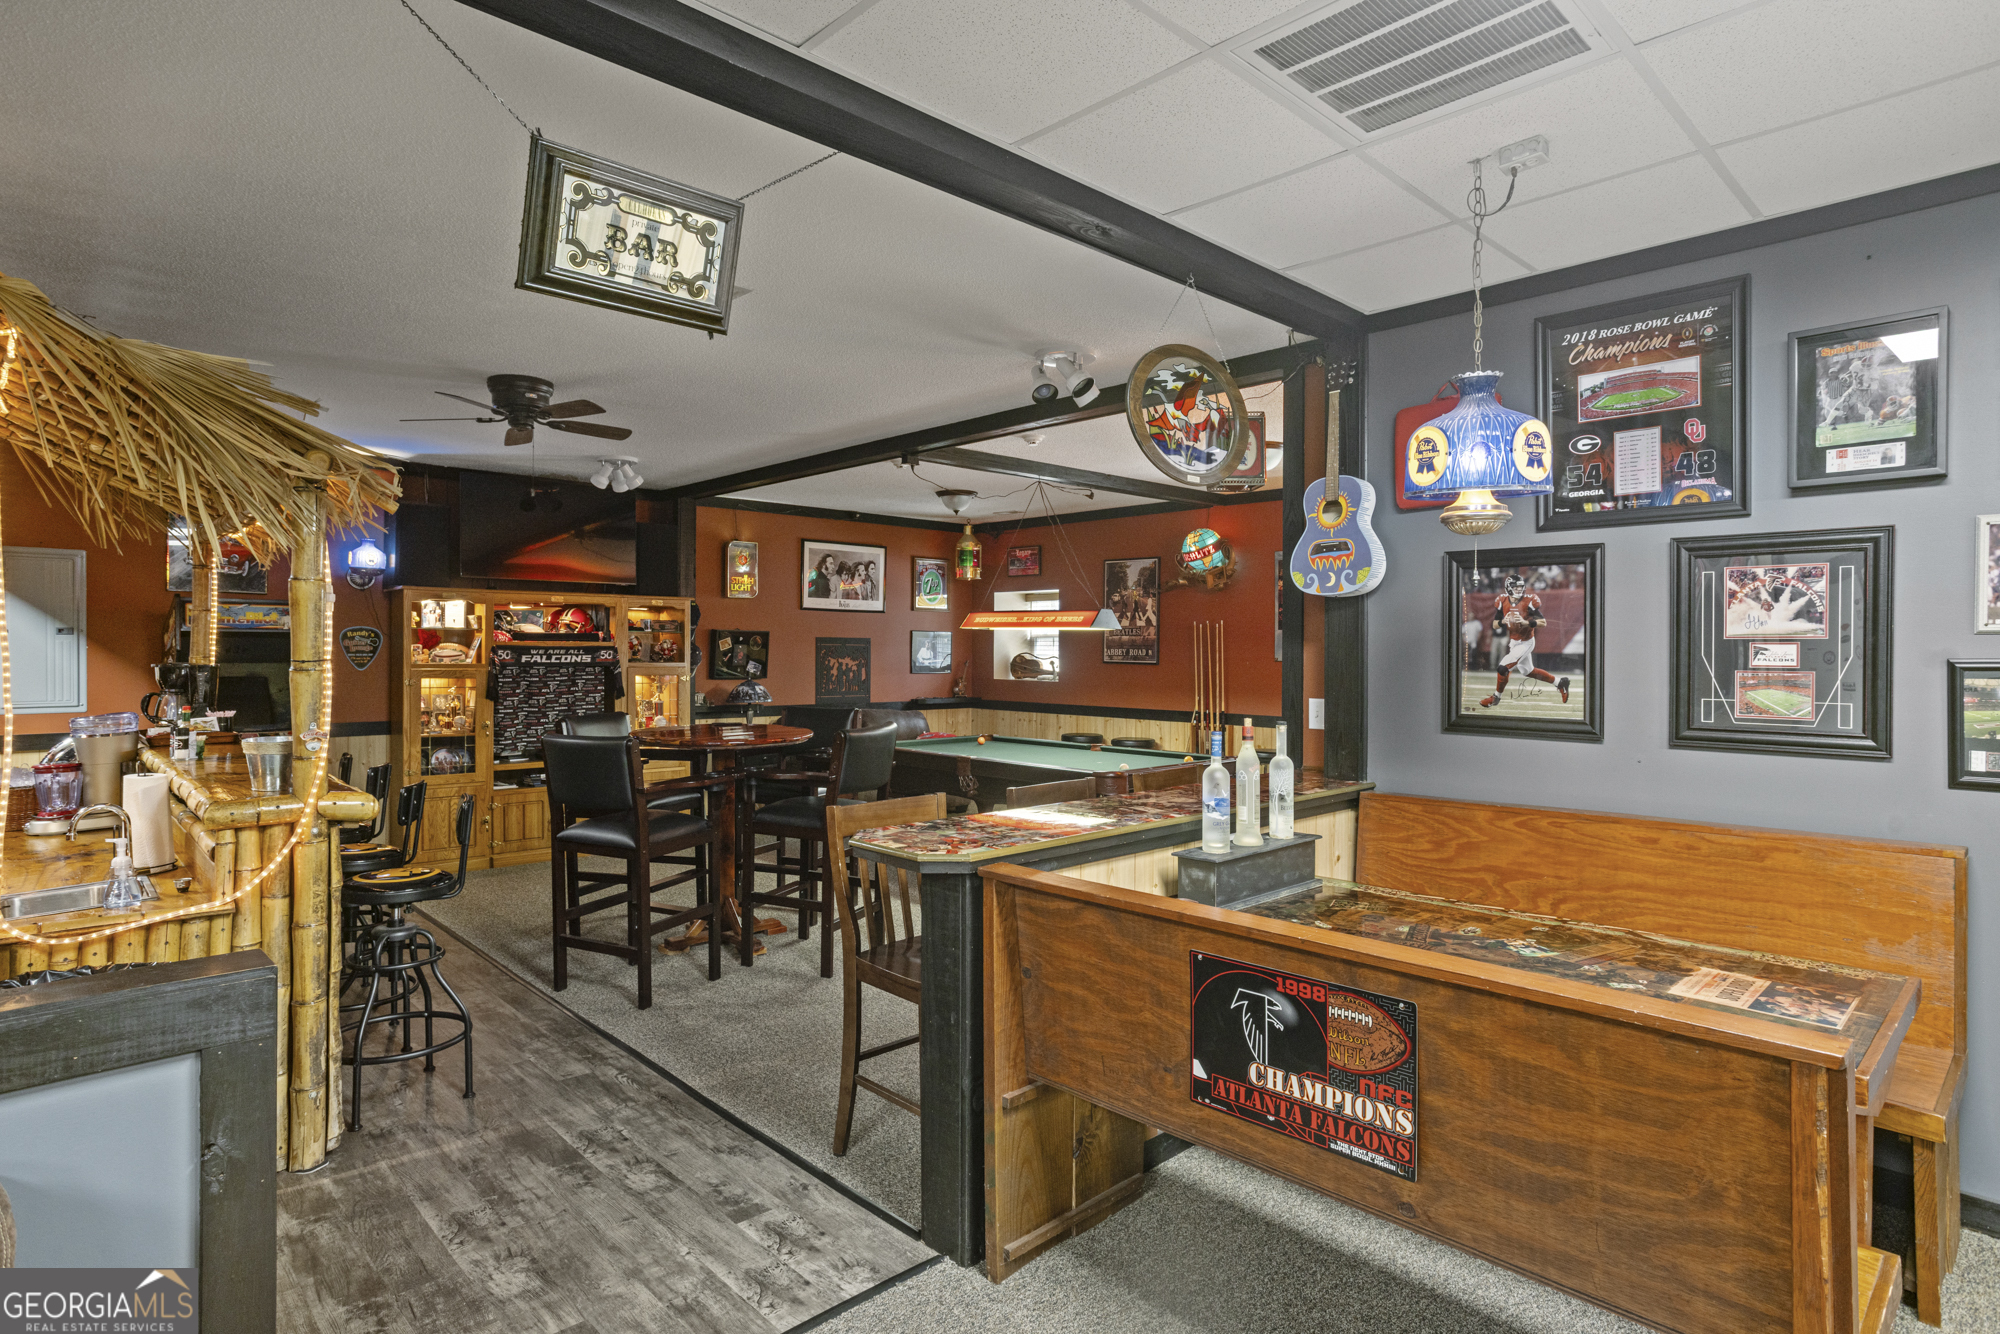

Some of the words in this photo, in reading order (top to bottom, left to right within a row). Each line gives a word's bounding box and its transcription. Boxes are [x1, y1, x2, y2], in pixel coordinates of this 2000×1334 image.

[631, 219, 660, 232] private
[604, 223, 678, 268] BAR
[1562, 329, 1597, 345] 2018
[1598, 324, 1631, 339] ROSE
[1633, 317, 1671, 332] BOWL
[1568, 333, 1673, 366] Champions
[1821, 344, 1856, 357] Sports
[1675, 449, 1716, 475] 48
[1567, 463, 1603, 488] 54
[1568, 489, 1605, 498] GEORGIA
[731, 583, 751, 591] LIGHT
[1113, 628, 1141, 636] BEATLES
[498, 650, 511, 660] 50
[521, 654, 591, 663] FALCONS
[600, 650, 613, 659] 50
[1129, 648, 1147, 656] ROAD
[1276, 976, 1326, 1003] 1998
[1330, 1041, 1366, 1066] NFL
[1248, 1062, 1415, 1136] CHAMPIONS
[1360, 1078, 1413, 1109] NFC
[1213, 1079, 1303, 1125] ATLANTA
[1310, 1111, 1411, 1163] FALCONS
[1330, 1143, 1351, 1155] SUPER
[1352, 1150, 1373, 1162] BOWL
[1336, 1140, 1349, 1149] THE
